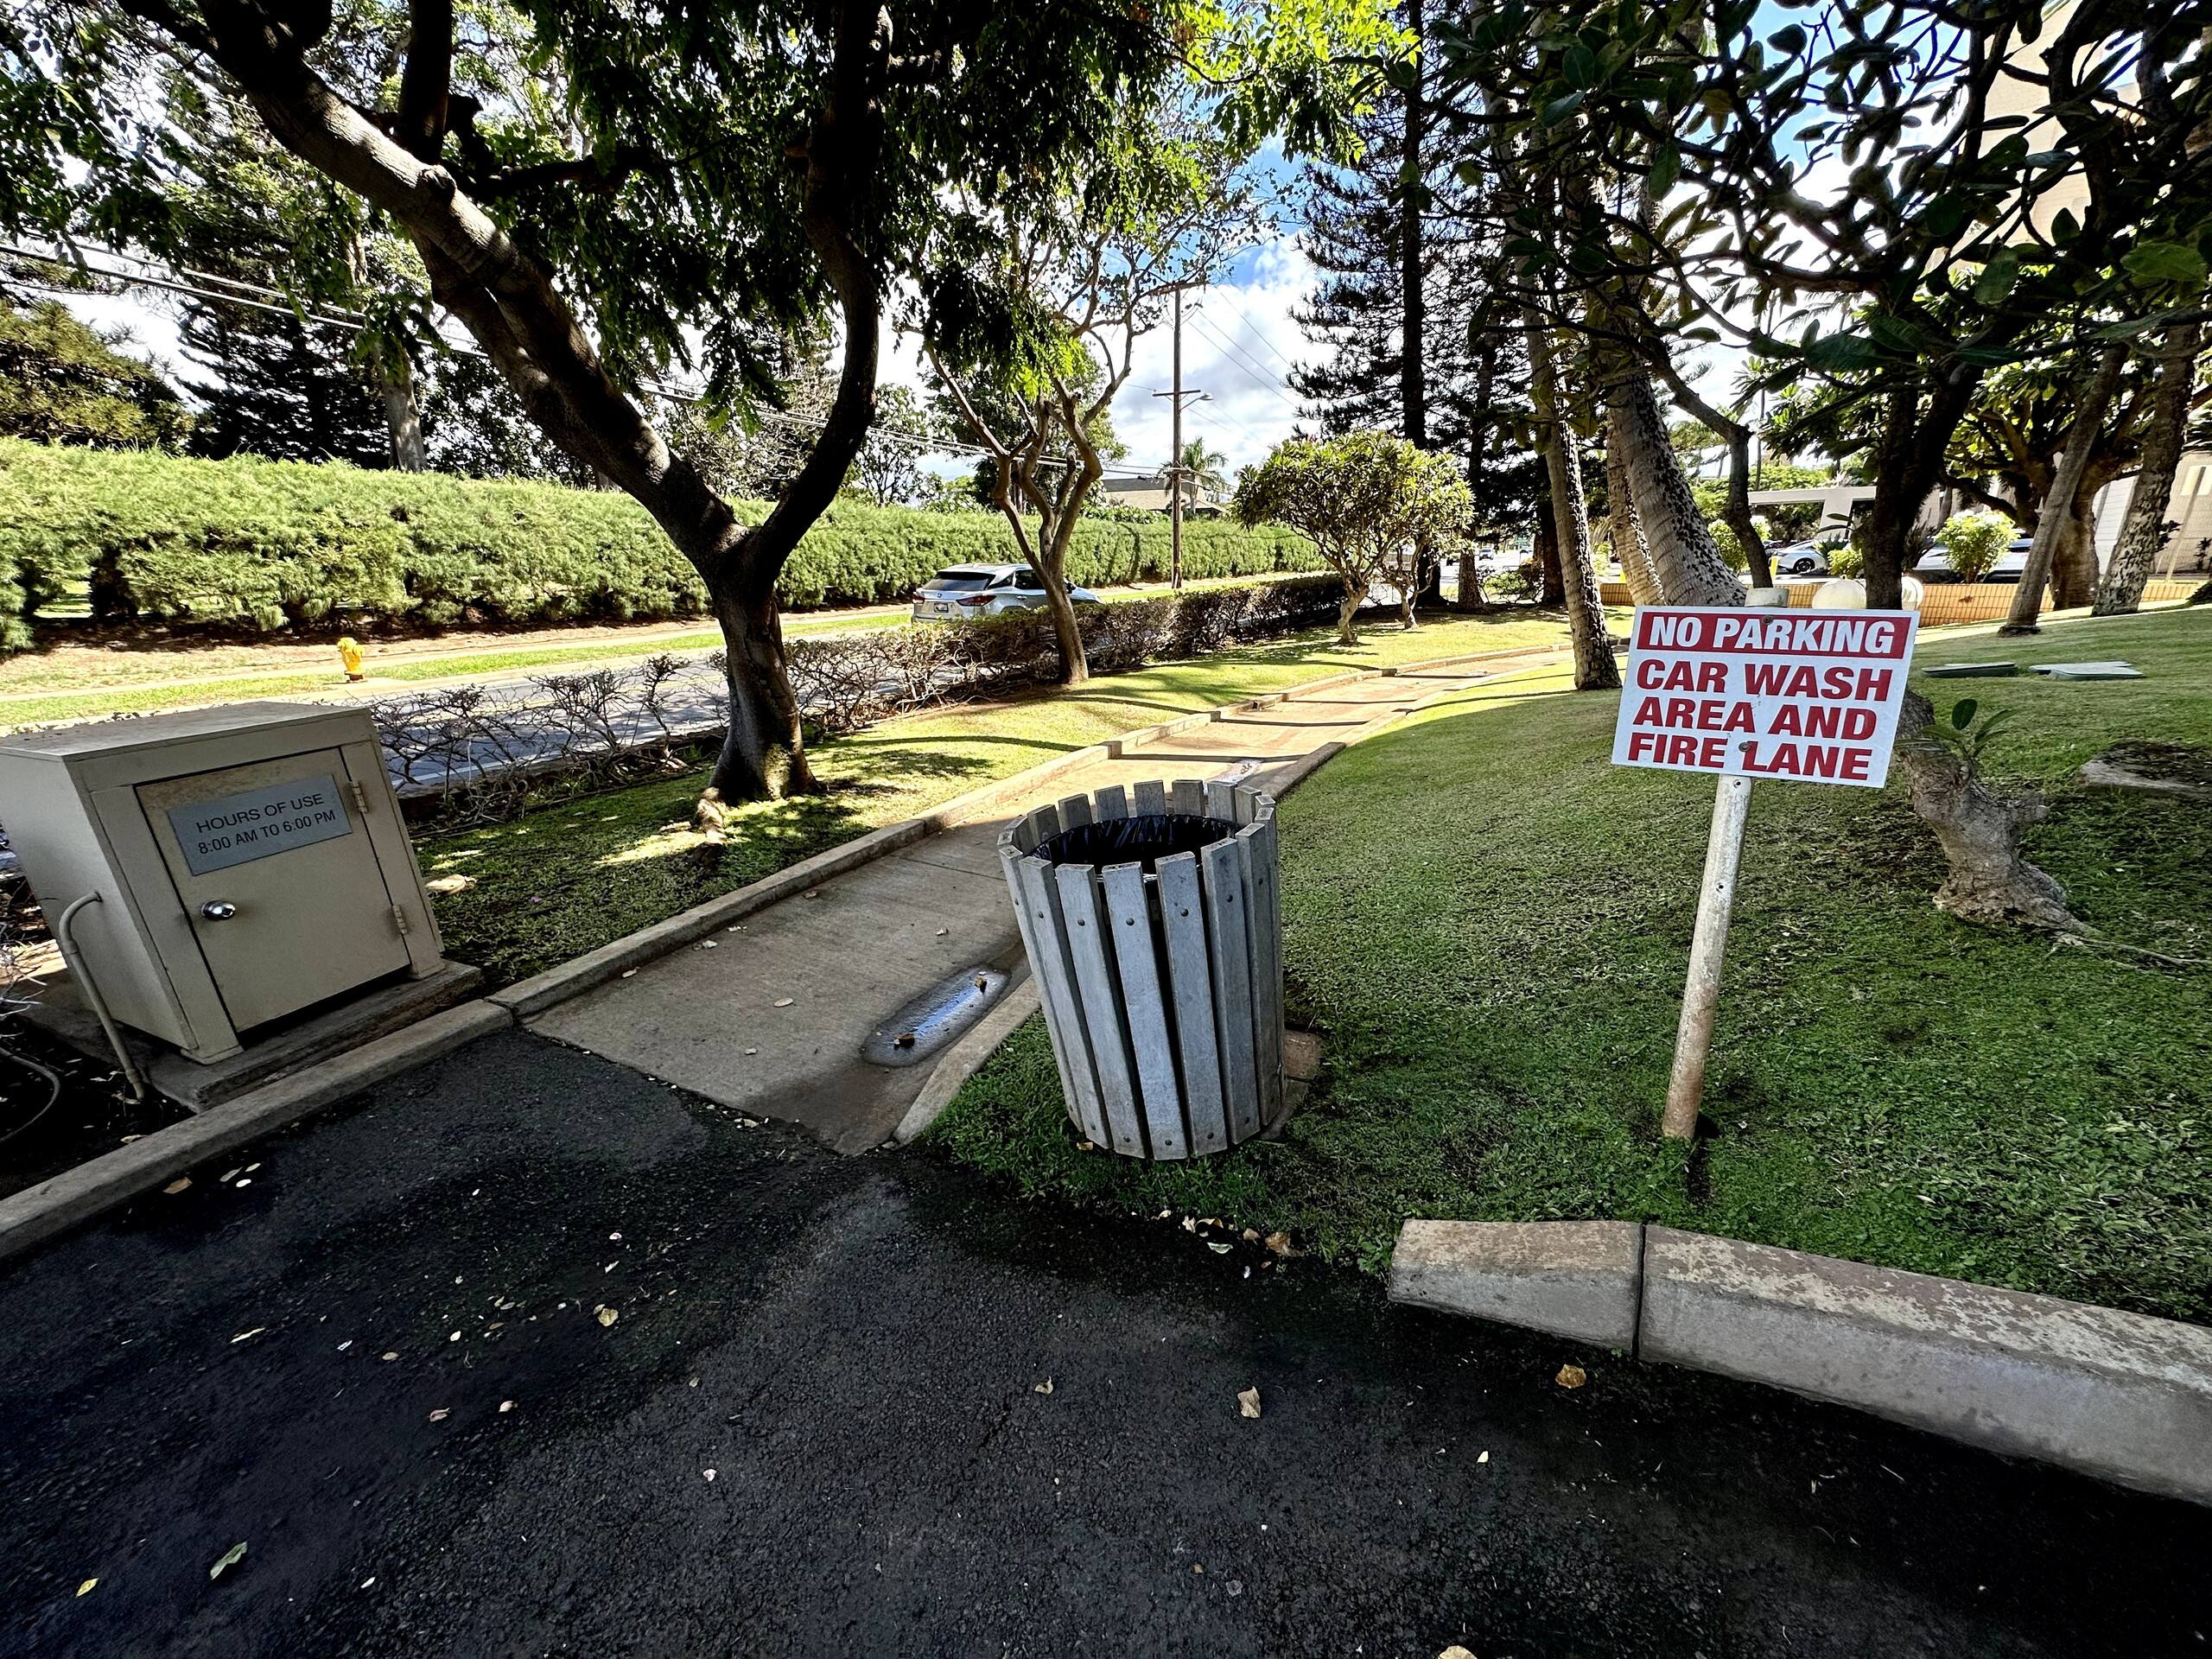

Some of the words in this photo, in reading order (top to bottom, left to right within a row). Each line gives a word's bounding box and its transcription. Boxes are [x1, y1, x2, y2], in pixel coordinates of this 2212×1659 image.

[1649, 616, 1701, 647] NO
[1713, 617, 1894, 654] PARKING
[1637, 659, 1728, 692] CAR
[1745, 664, 1892, 702] WASH
[1633, 696, 1755, 734] AREA
[1768, 703, 1877, 741] AND
[1628, 733, 1728, 768] FIRE
[1742, 741, 1872, 780] LANE
[196, 809, 261, 833] HOURS
[264, 803, 287, 816] OF
[291, 794, 324, 810] USE
[199, 836, 231, 855] 8:00
[236, 830, 258, 845] AM
[260, 824, 279, 837] TO
[283, 816, 312, 832] 6:00
[315, 810, 335, 824] PM
